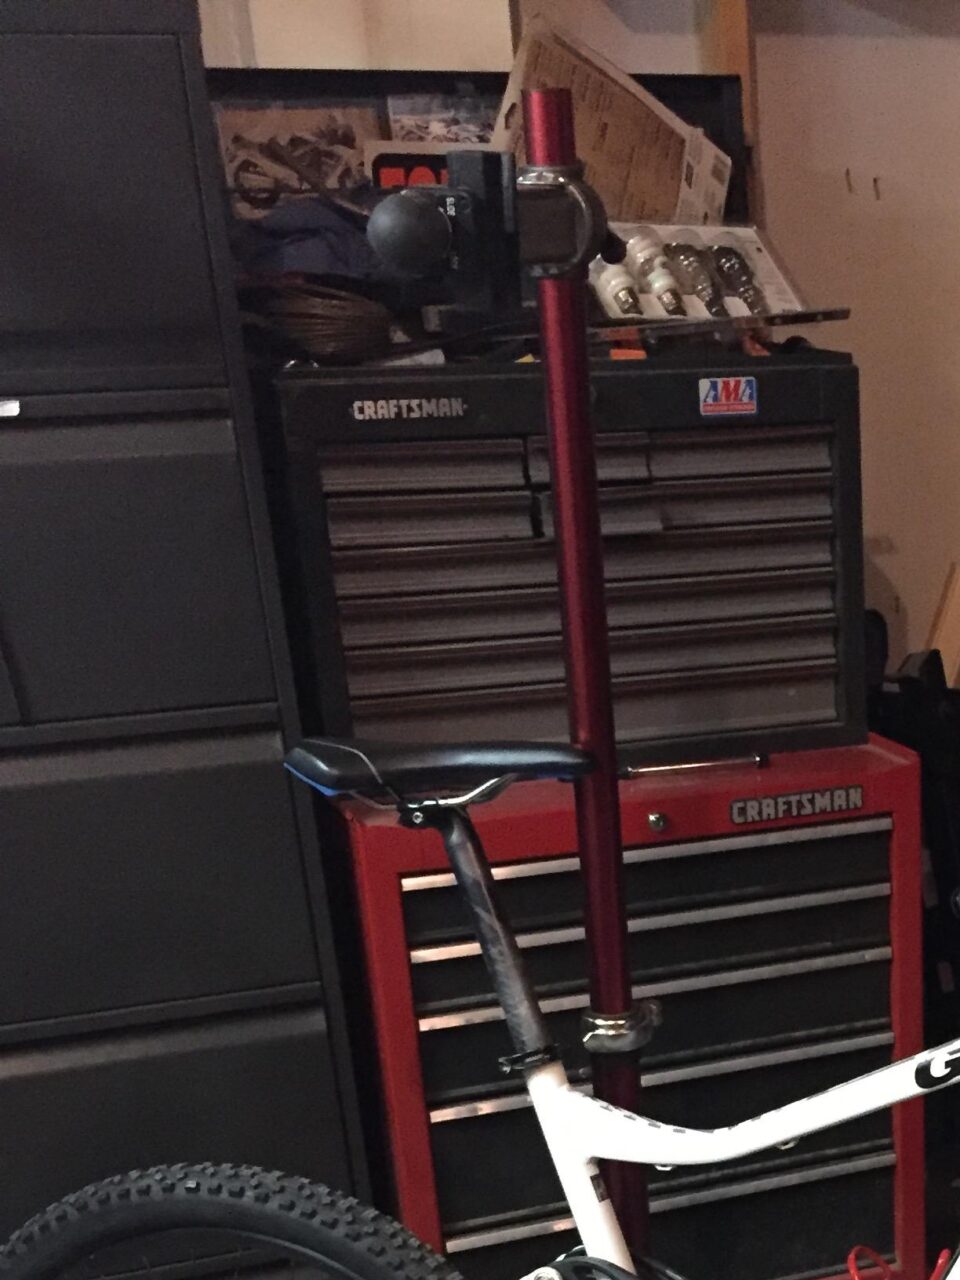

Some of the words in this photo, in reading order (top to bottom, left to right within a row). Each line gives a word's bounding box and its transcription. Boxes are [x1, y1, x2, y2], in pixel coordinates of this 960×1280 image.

[703, 379, 755, 403] AMA
[352, 398, 464, 420] CRAFTSMAN
[731, 787, 863, 824] CRAFTSMAN
